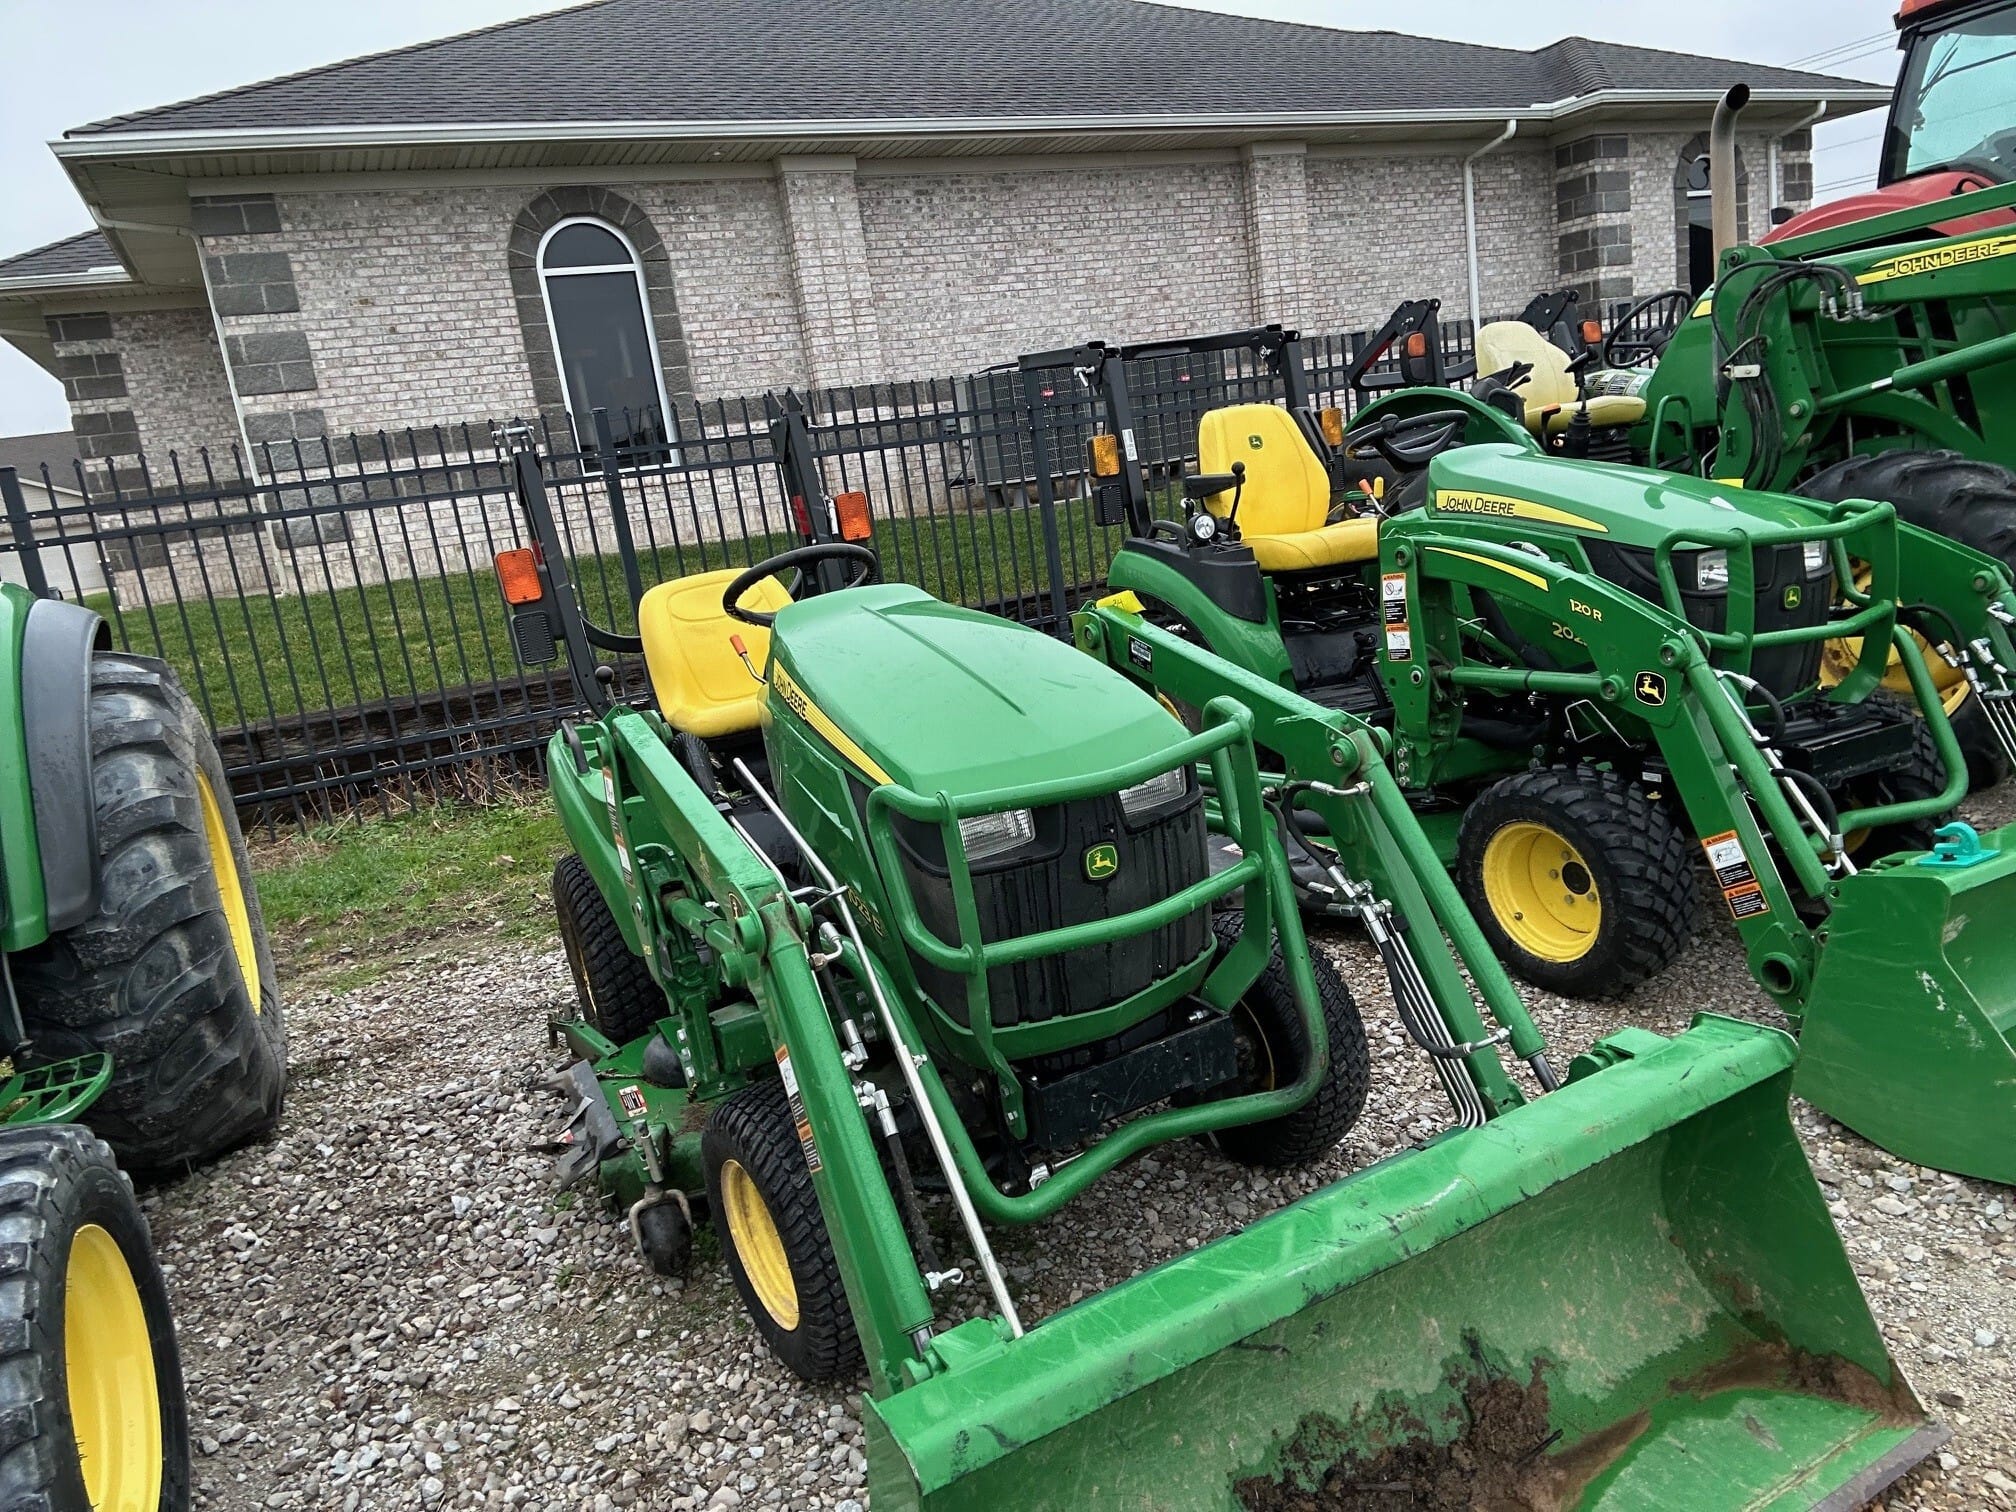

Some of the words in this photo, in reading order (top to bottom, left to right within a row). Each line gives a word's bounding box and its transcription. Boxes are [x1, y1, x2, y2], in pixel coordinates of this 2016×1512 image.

[1887, 255, 1938, 277] JOHN
[1939, 242, 2001, 266] DEERE
[1442, 495, 1473, 511] JOHN
[1474, 497, 1515, 515] DEERE
[786, 681, 807, 719] DEERE
